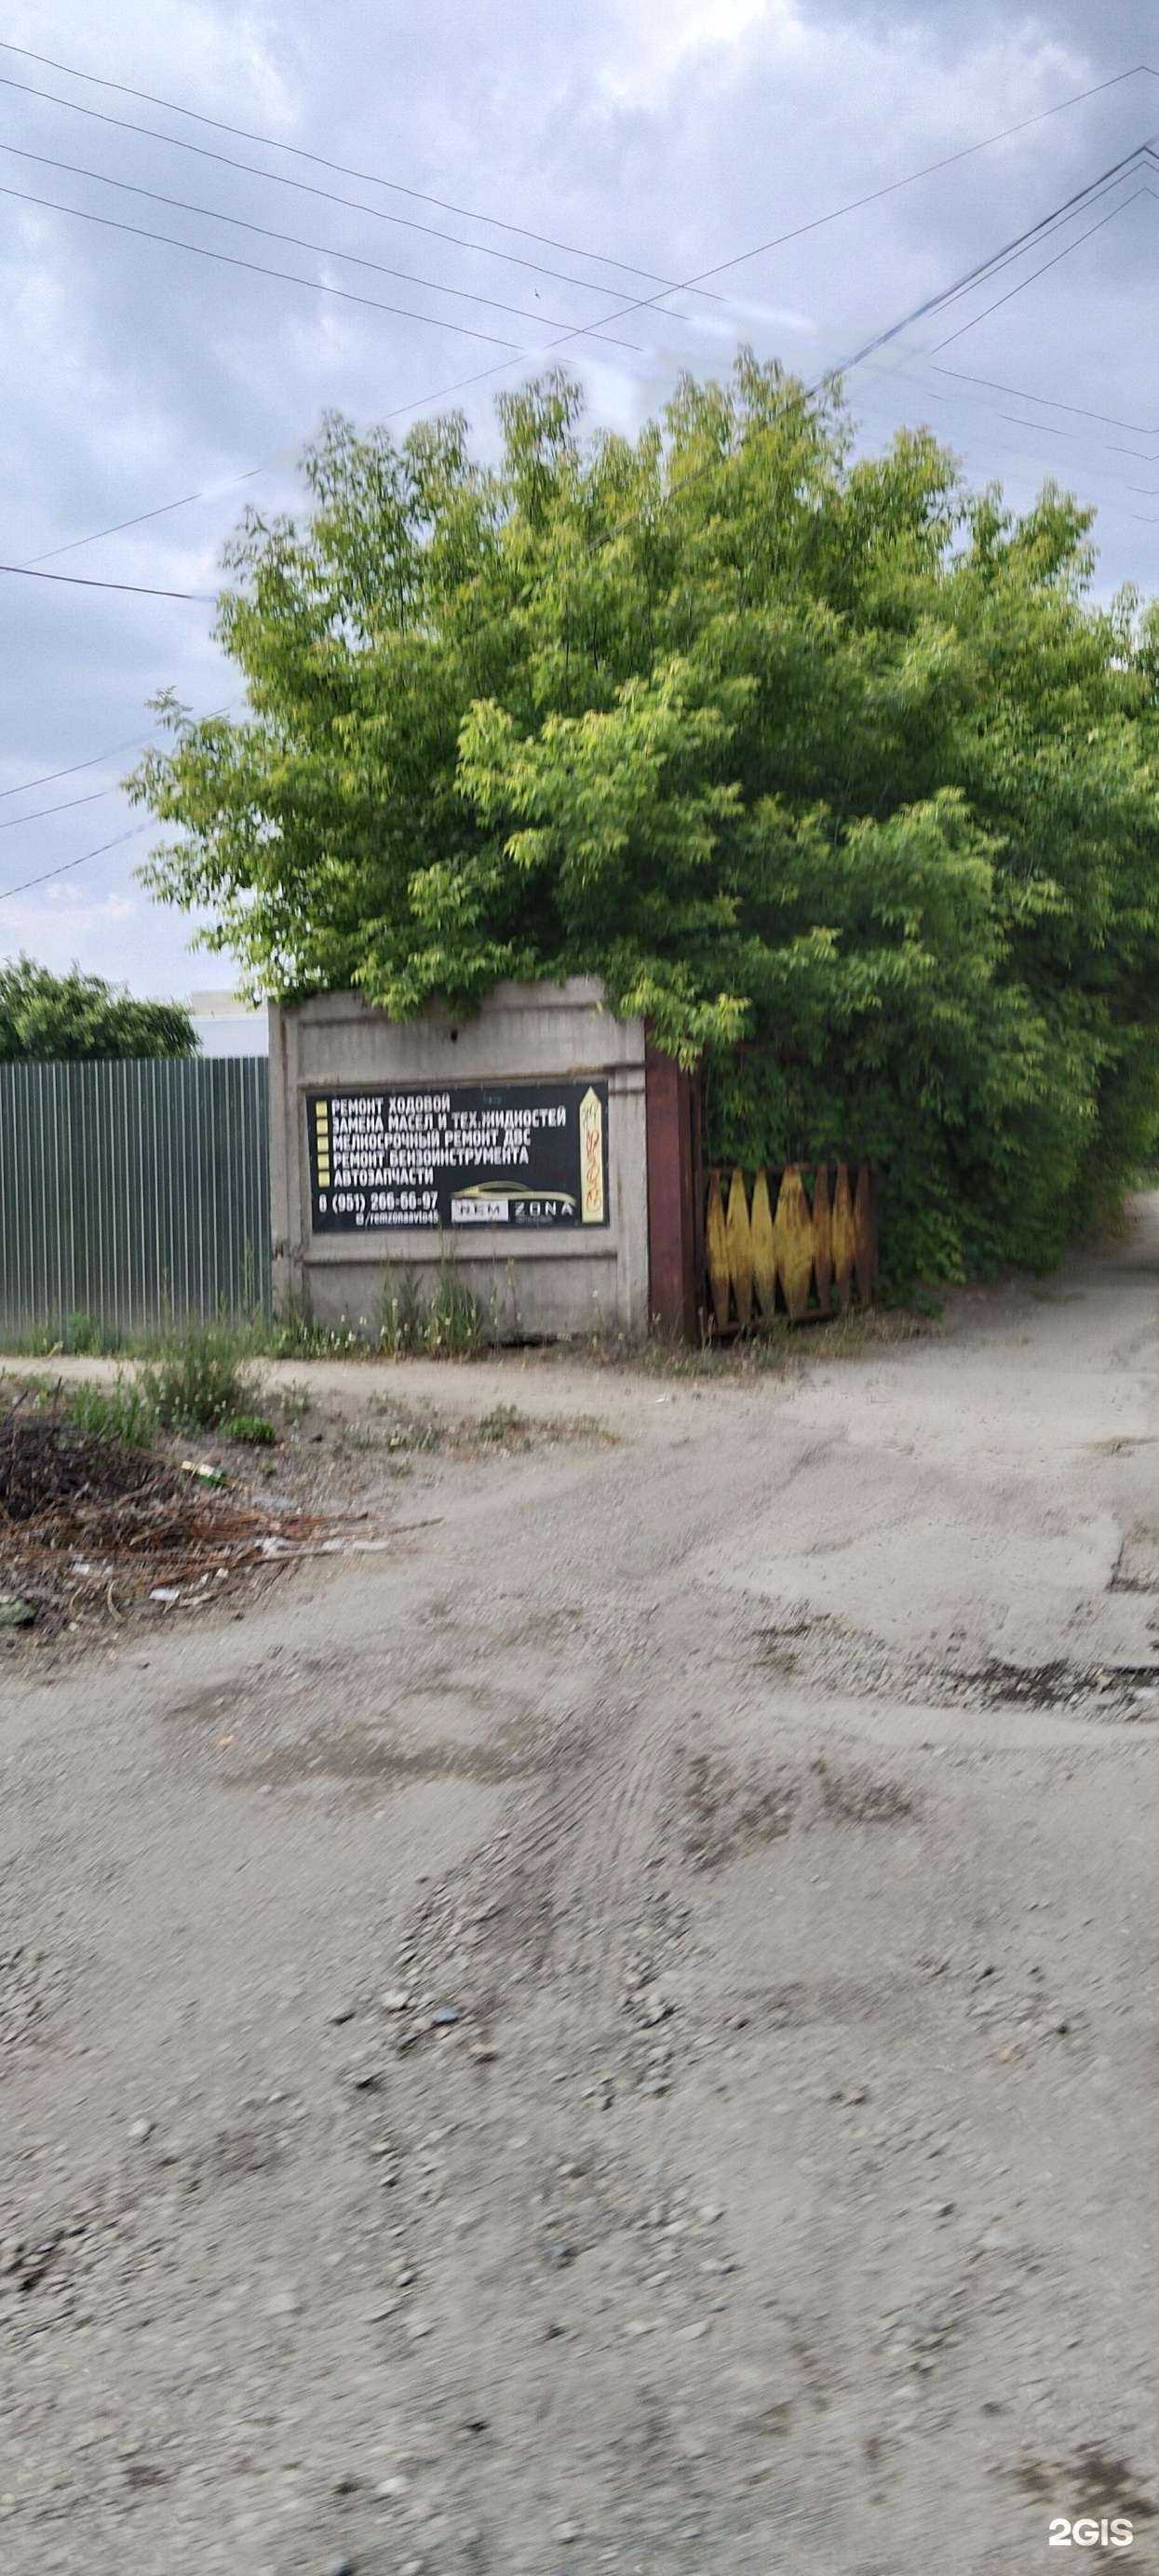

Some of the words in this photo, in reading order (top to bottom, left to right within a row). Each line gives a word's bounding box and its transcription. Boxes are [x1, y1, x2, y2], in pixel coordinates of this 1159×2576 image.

[331, 1097, 384, 1117] РЕМОНТ
[389, 1093, 451, 1115] ХОДОВОЙ
[332, 1114, 384, 1134] ЗАМЕНА
[388, 1113, 434, 1133] МАСЕЛ
[438, 1112, 447, 1131] И
[451, 1105, 567, 1130] ТЕХ.ЖИДКОСТЕЙ
[332, 1127, 440, 1152] МЕЛКОСРОЧНЫЙ
[445, 1129, 499, 1147] РЕМОНТ
[503, 1127, 532, 1147] ДВС
[333, 1150, 384, 1170] РЕМОНТ
[389, 1146, 529, 1169] БЕНЗОИНСТРУМЕНТА
[334, 1167, 434, 1188] АВТОЗАПЧАСТИ
[461, 1204, 500, 1215] REM
[515, 1201, 573, 1215] ZONA
